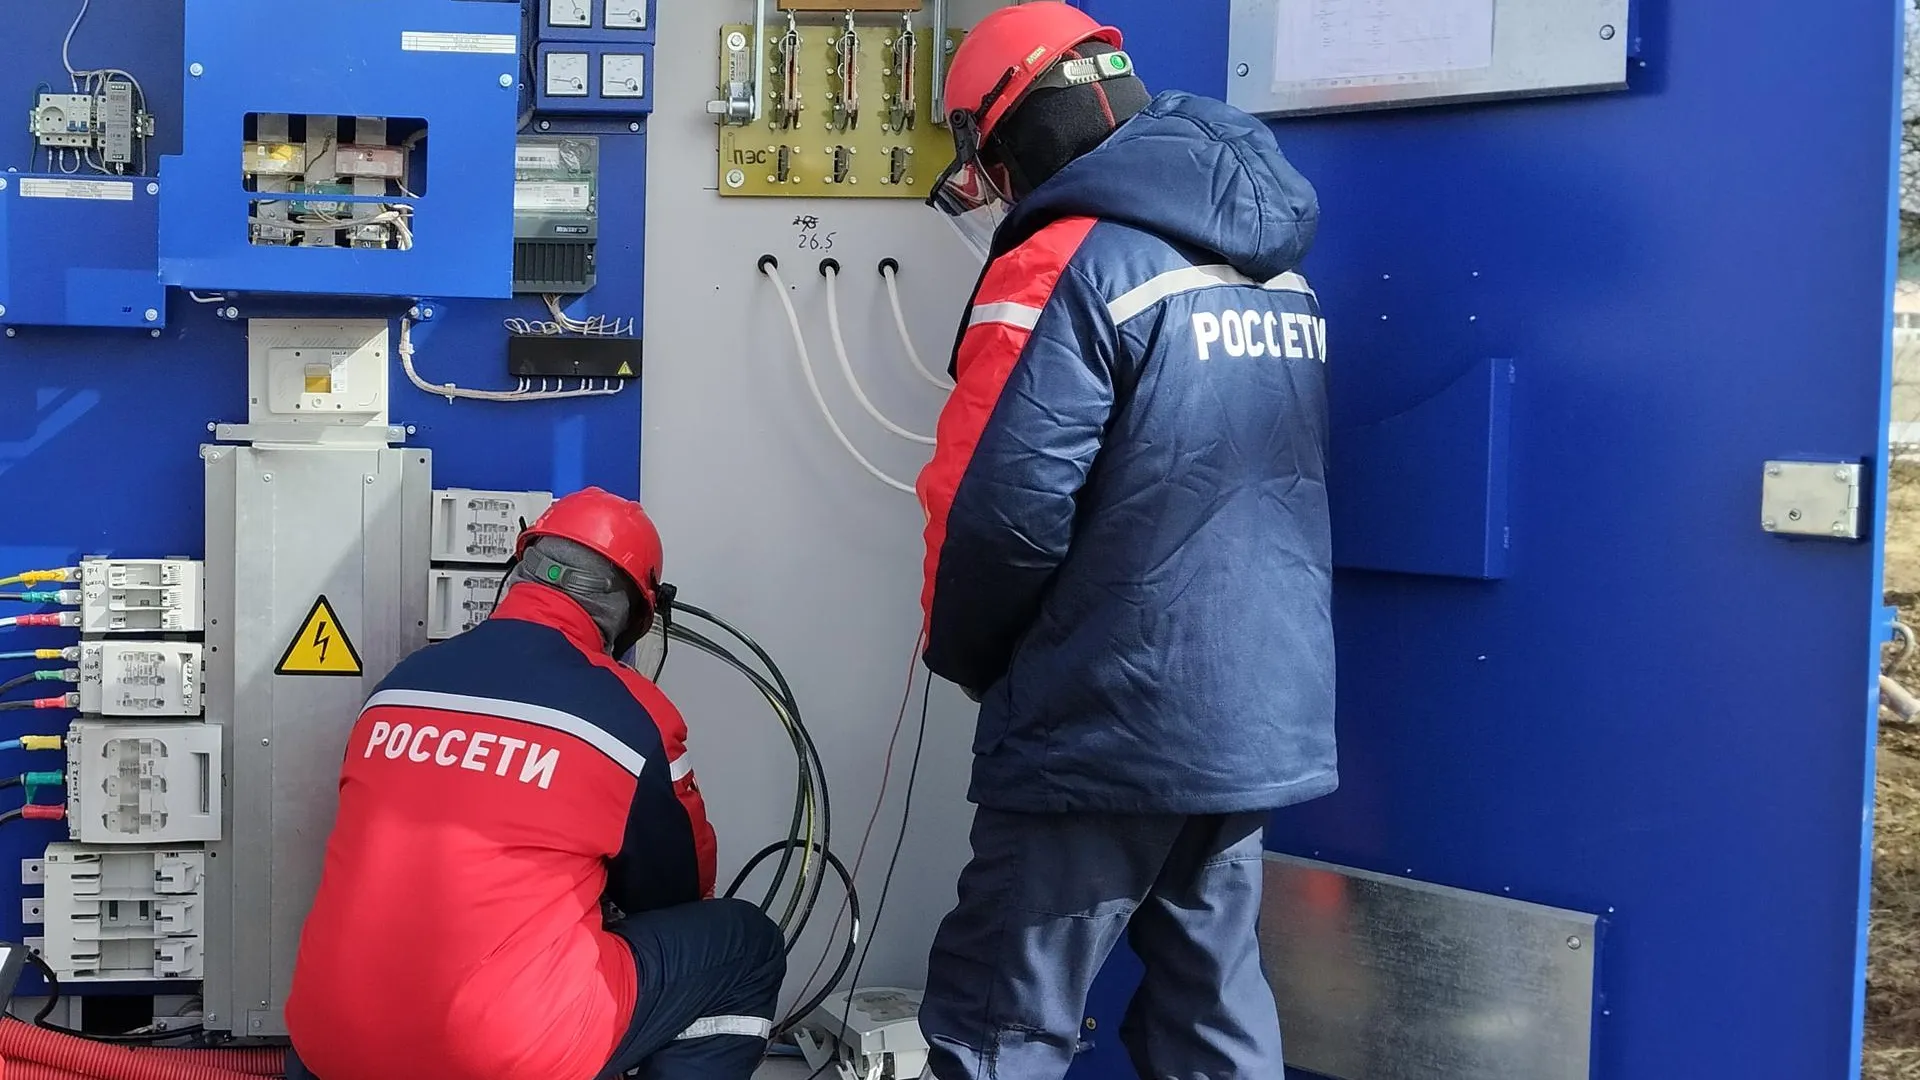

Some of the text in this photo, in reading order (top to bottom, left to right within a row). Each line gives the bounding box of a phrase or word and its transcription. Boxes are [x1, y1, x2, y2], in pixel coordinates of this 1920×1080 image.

[733, 149, 767, 165] ПЭС
[798, 231, 837, 250] 26.5
[1191, 309, 1327, 364] РОССЕТИ
[363, 721, 561, 790] РОССЕТИ
